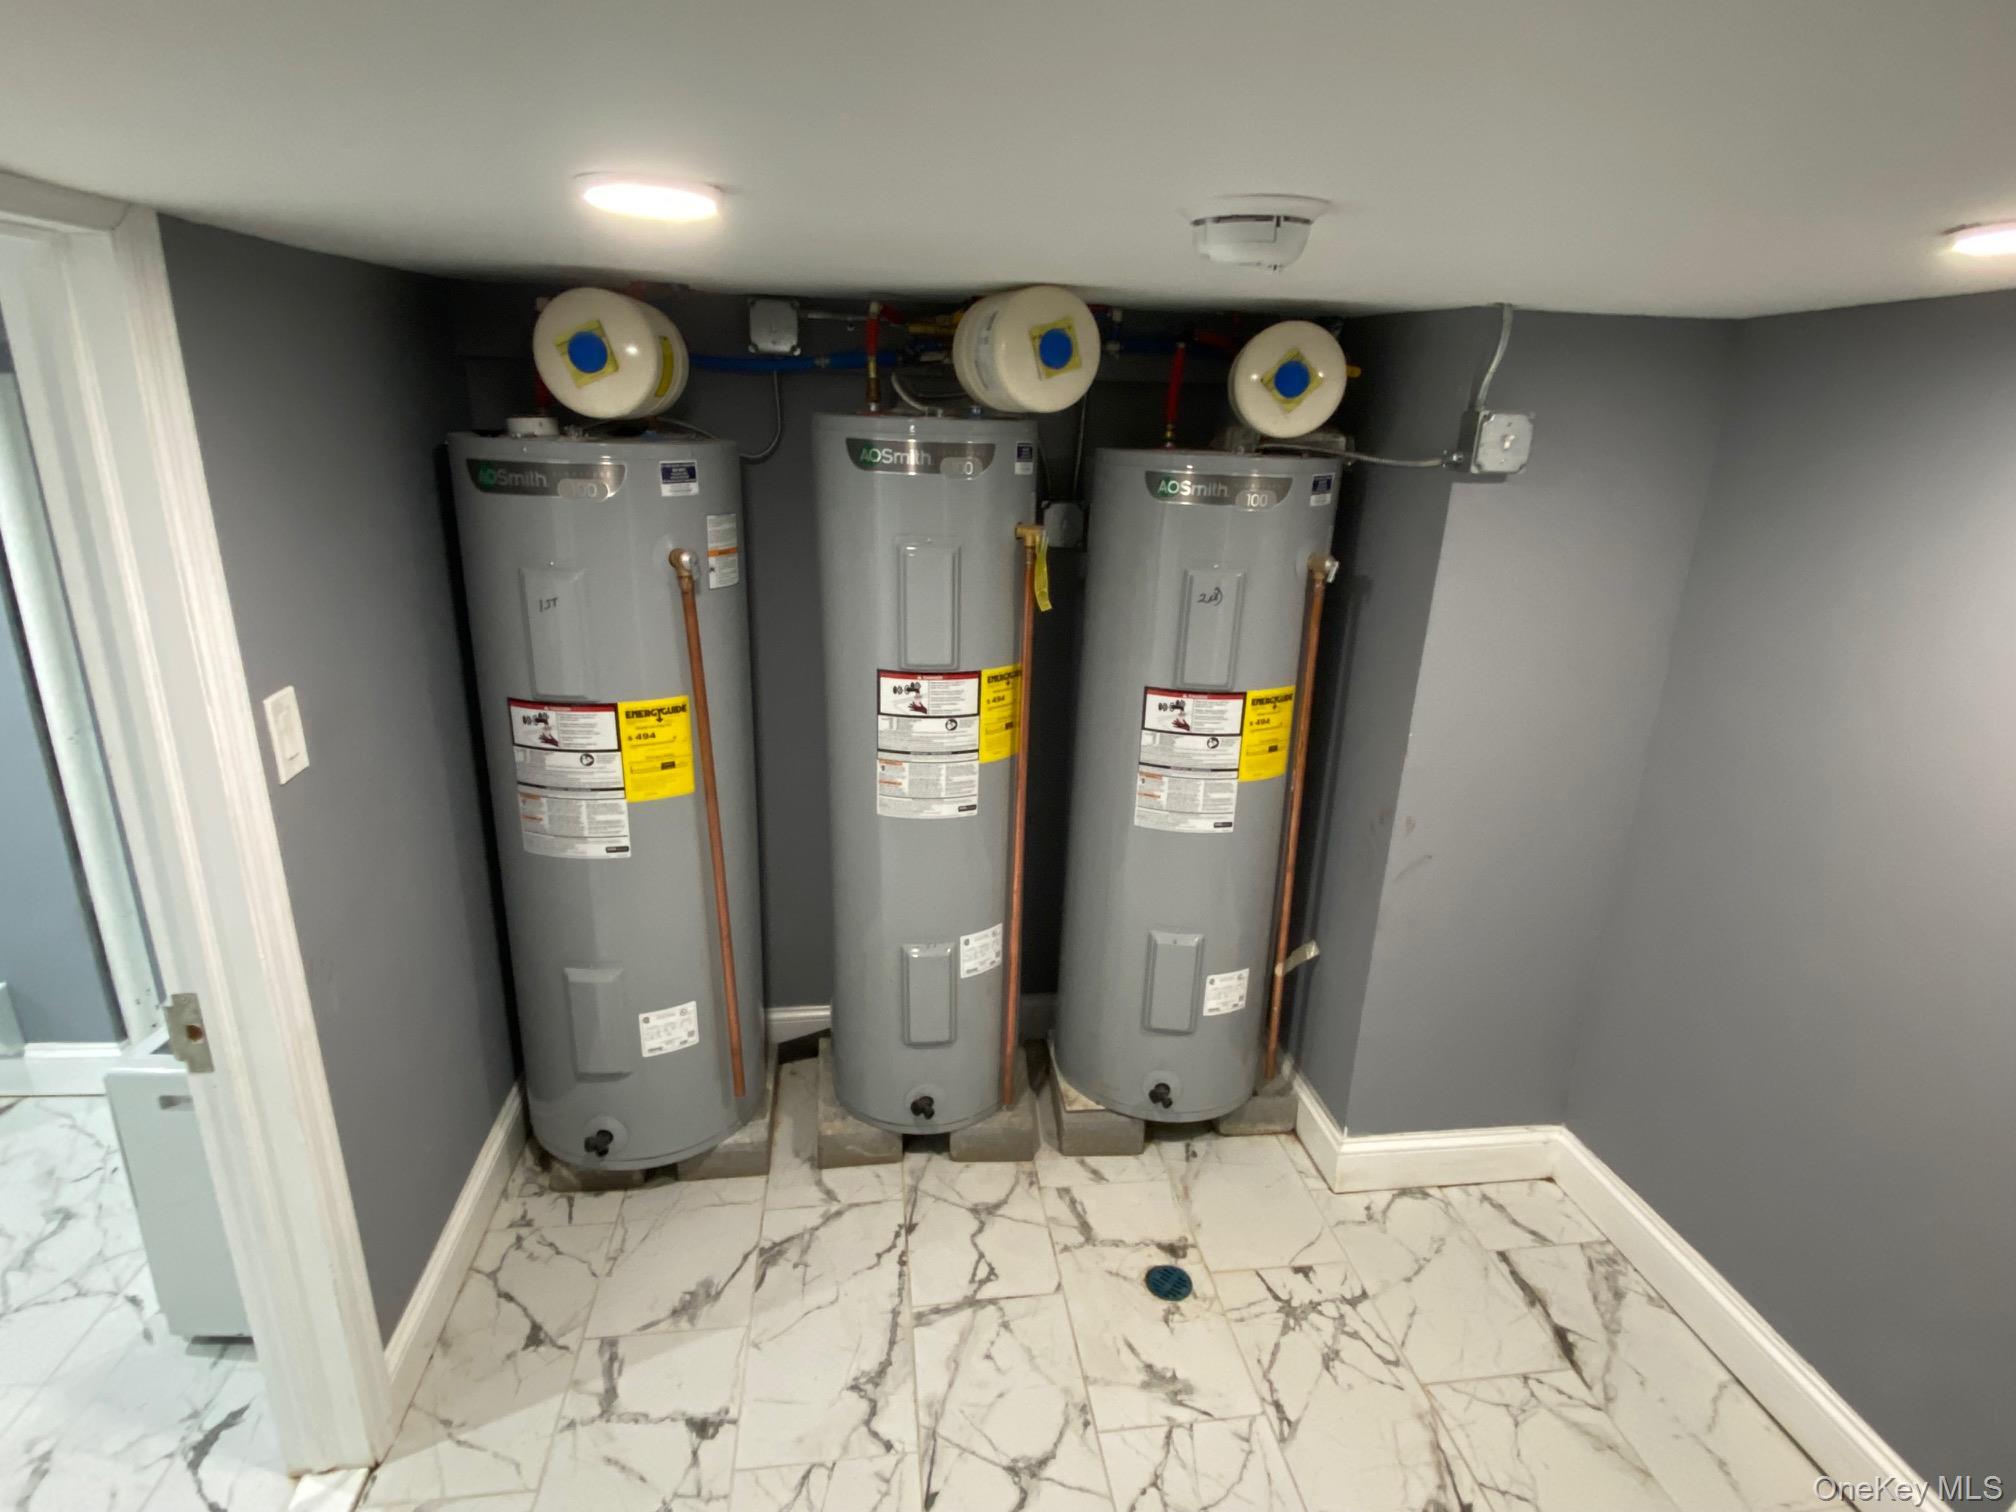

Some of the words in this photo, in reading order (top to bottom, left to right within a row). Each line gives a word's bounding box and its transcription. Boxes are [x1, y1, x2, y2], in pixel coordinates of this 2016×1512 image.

[1157, 480, 1228, 497] AOSmith
[1247, 493, 1268, 508] 100
[625, 704, 687, 720] ENERGYGUIDE
